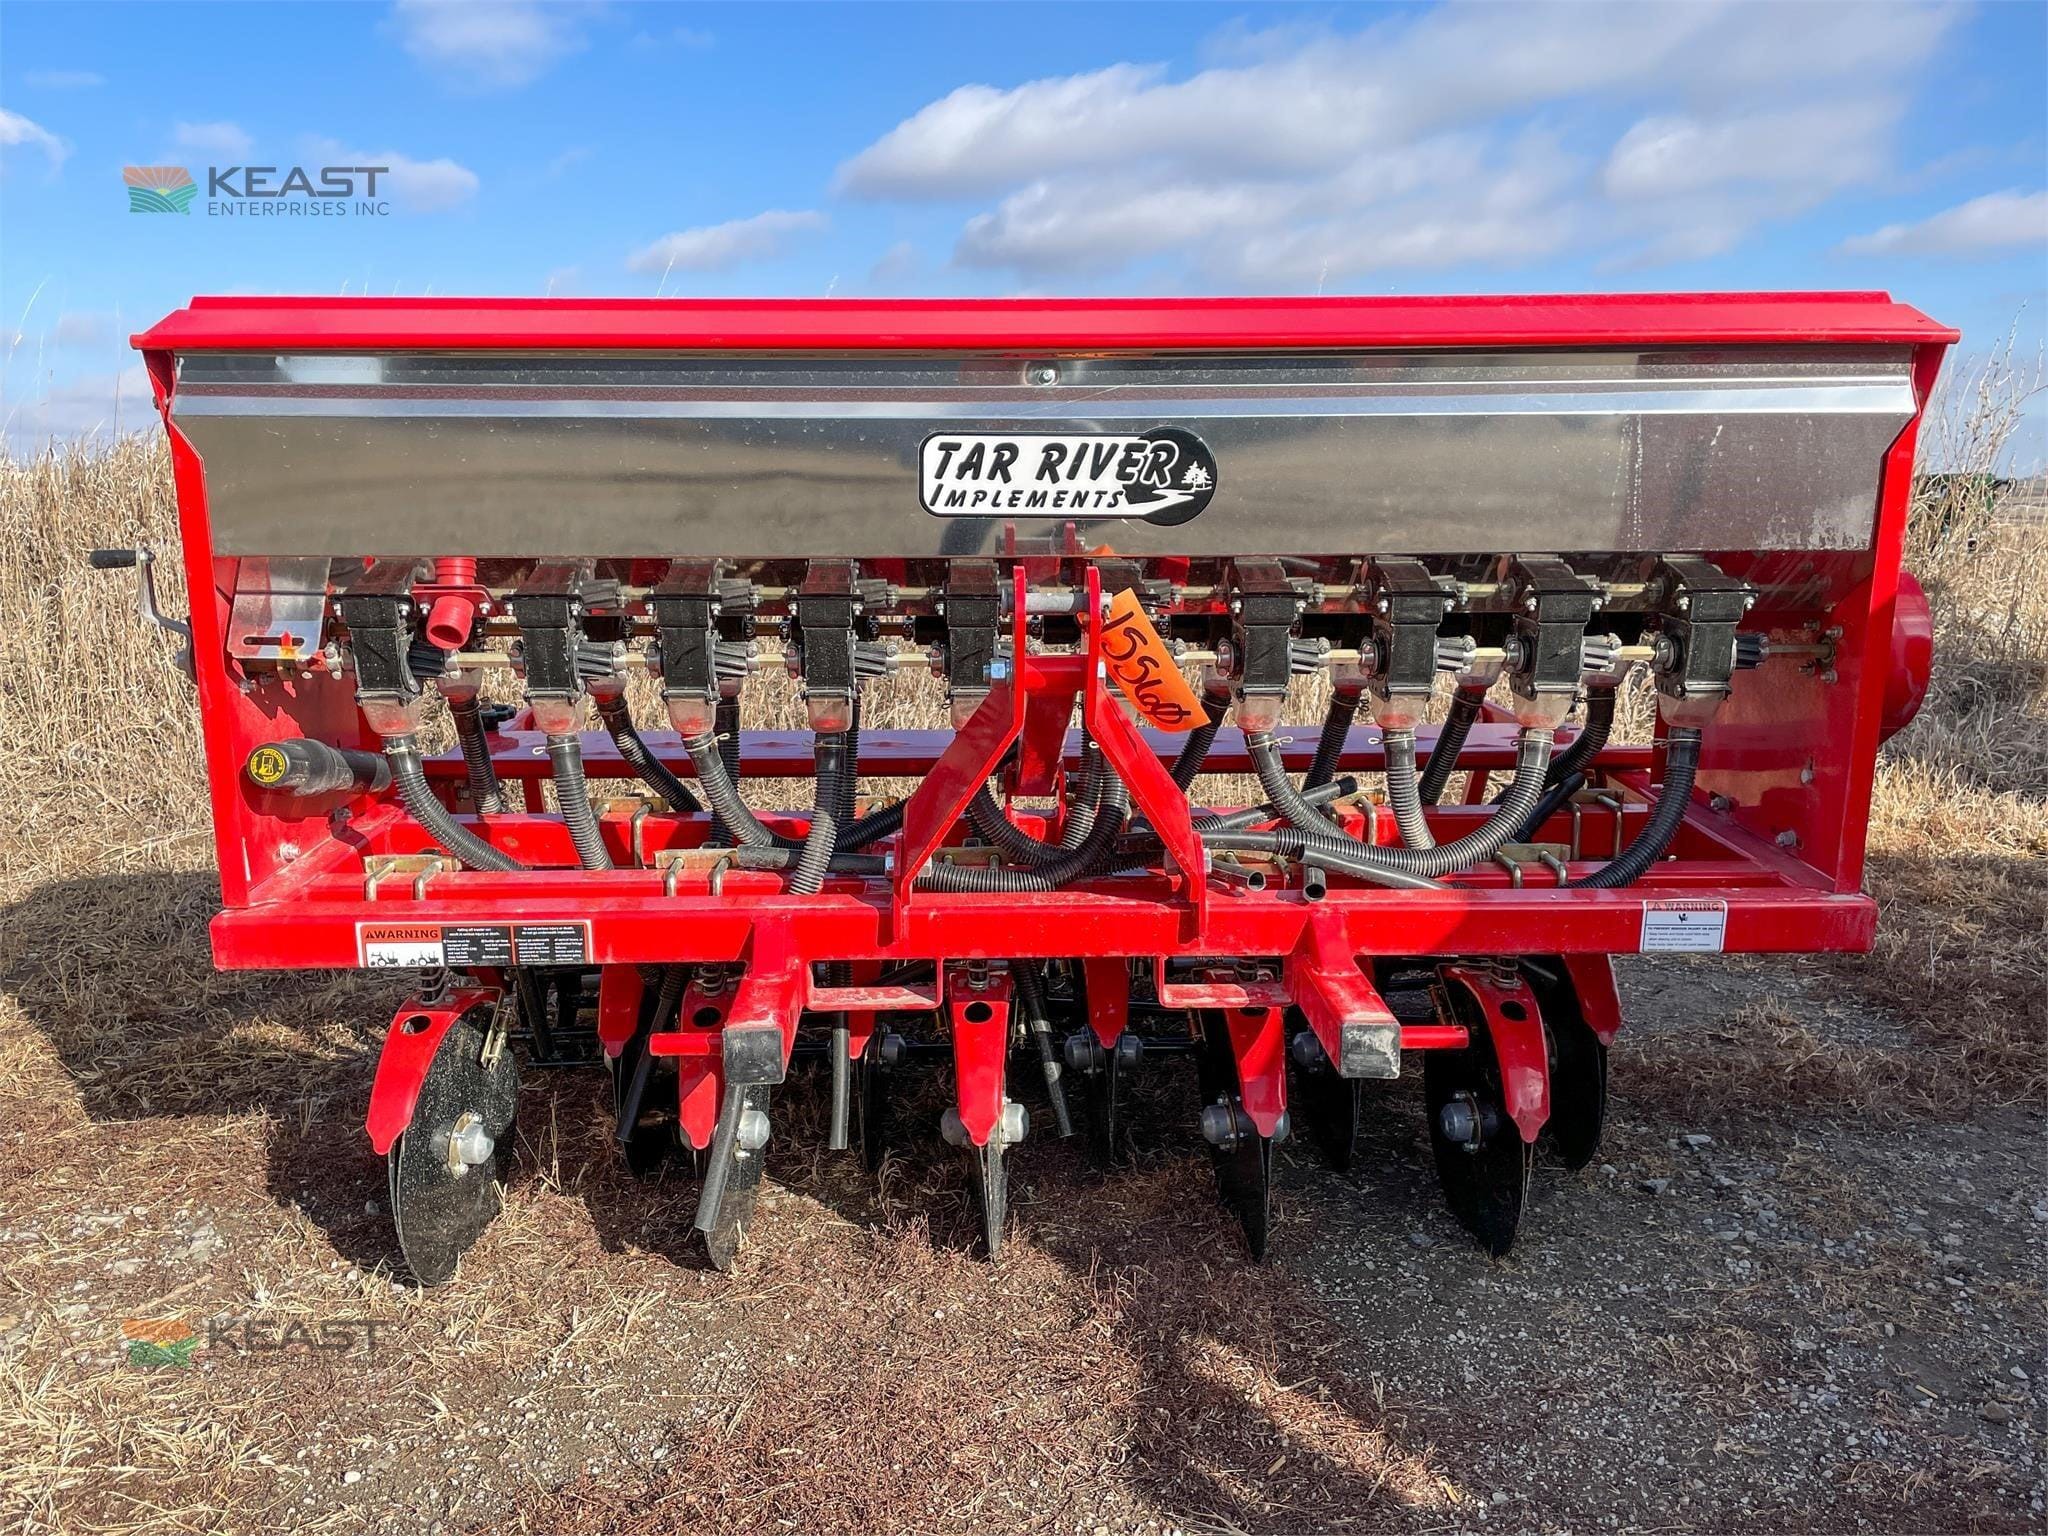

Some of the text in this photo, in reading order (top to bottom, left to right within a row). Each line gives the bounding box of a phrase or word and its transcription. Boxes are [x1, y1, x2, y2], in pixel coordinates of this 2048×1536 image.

[934, 441, 1178, 487] TAR RIVER
[1664, 902, 1720, 912] WARNING
[373, 929, 439, 940] WARNING
